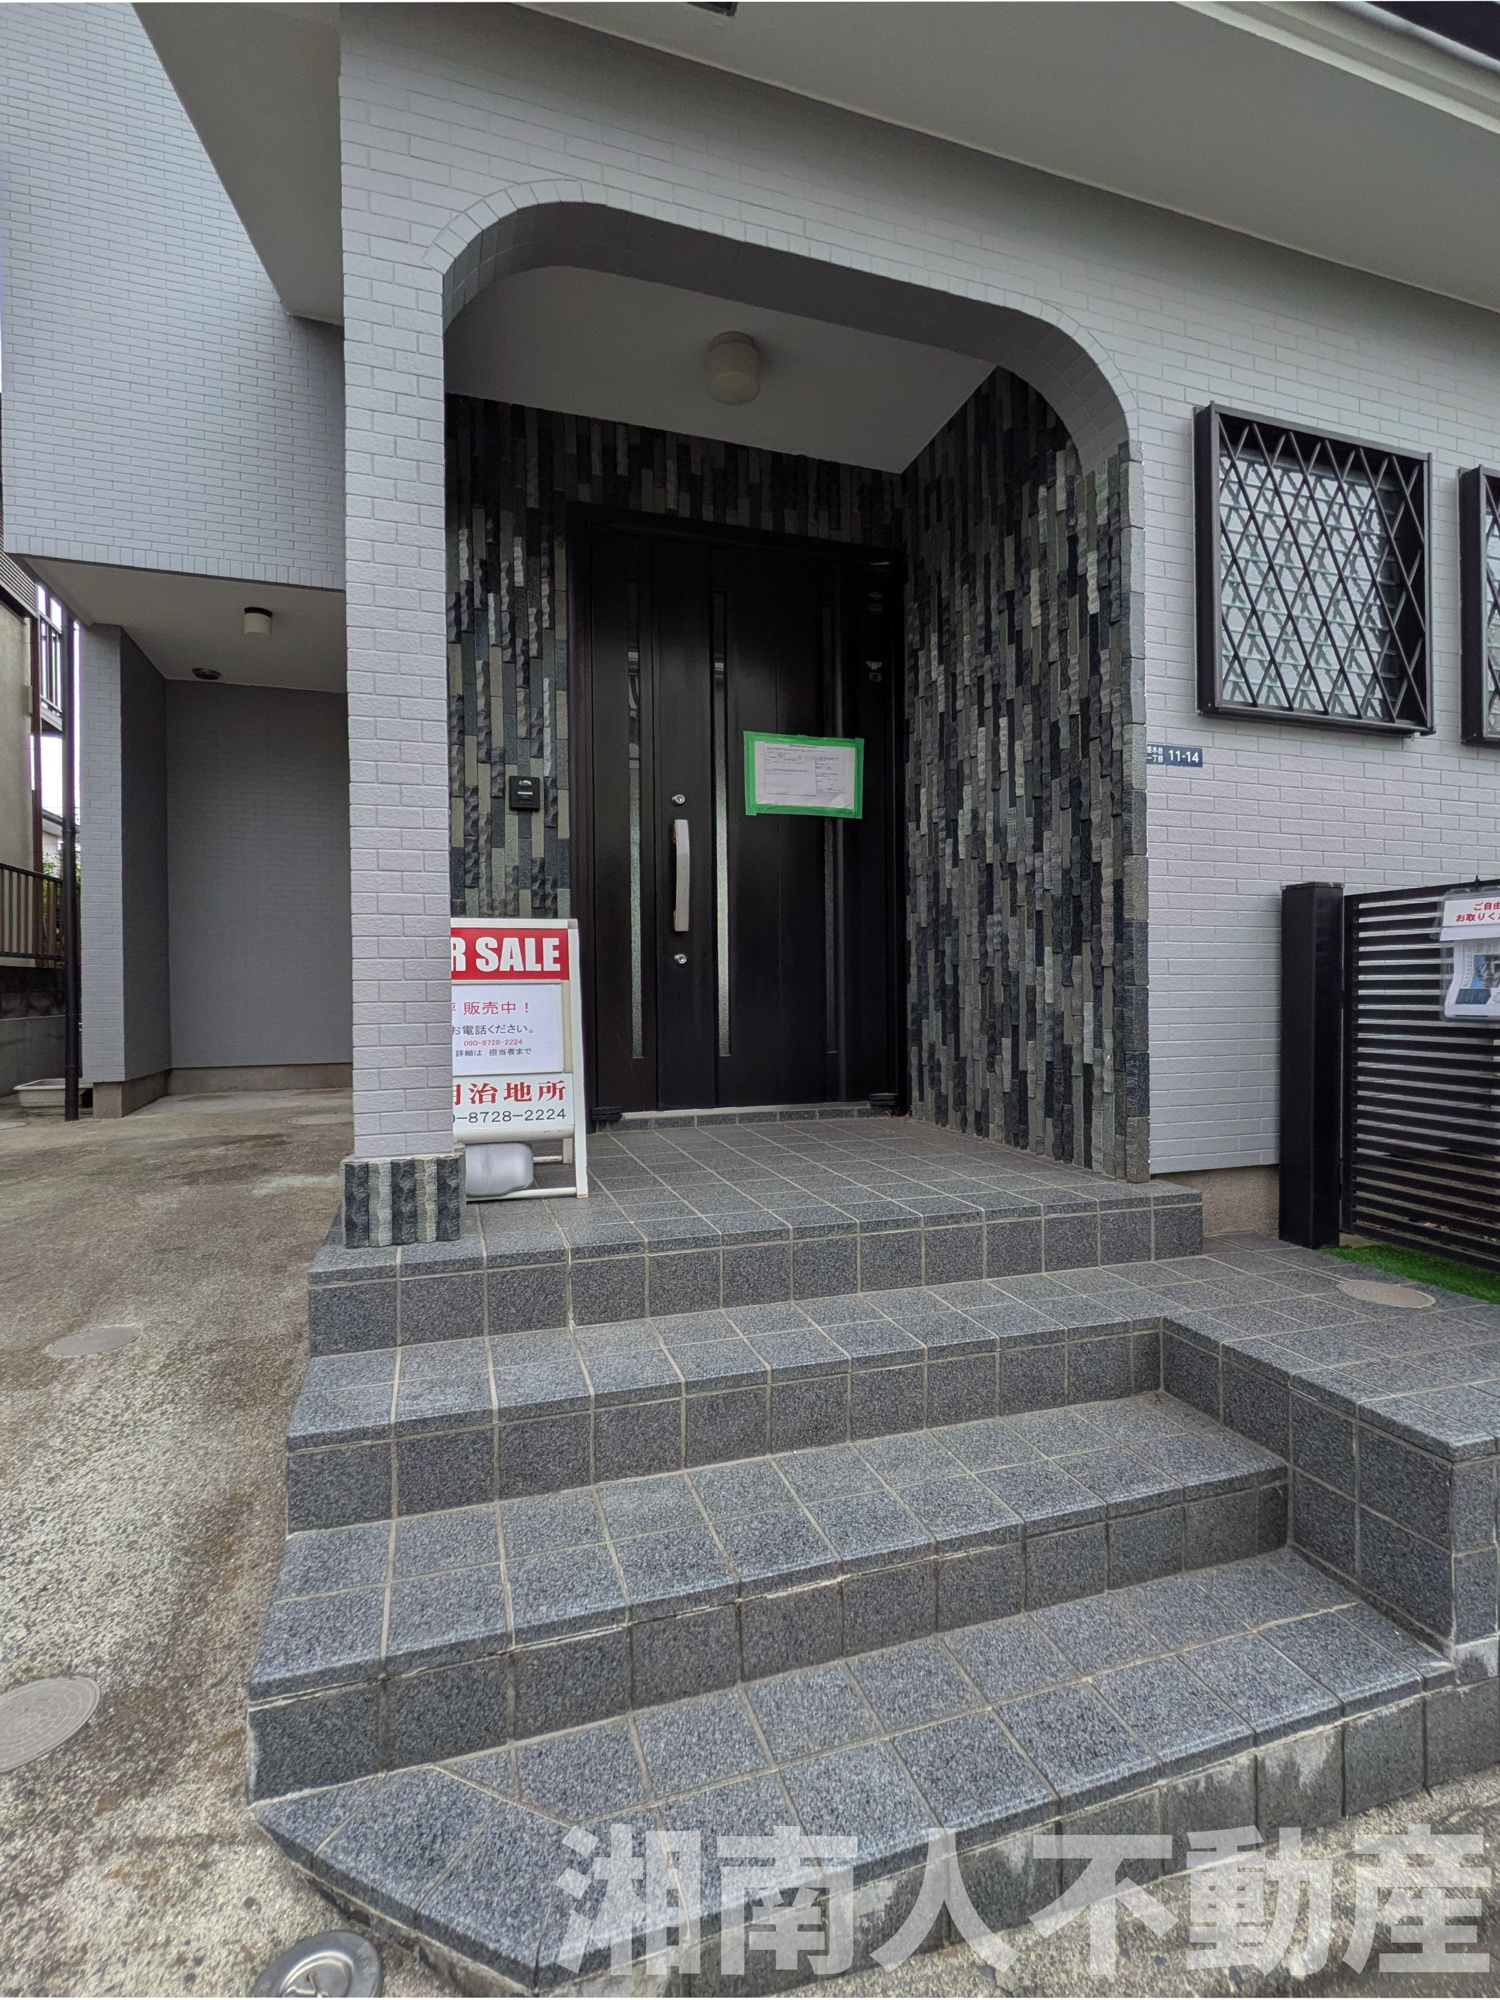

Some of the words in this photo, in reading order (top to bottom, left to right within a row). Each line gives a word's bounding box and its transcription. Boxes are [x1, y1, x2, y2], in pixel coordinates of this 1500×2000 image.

[1168, 750, 1199, 763] 11-14
[475, 937, 561, 972] SALE
[464, 1039, 523, 1047] 090-8728-2224
